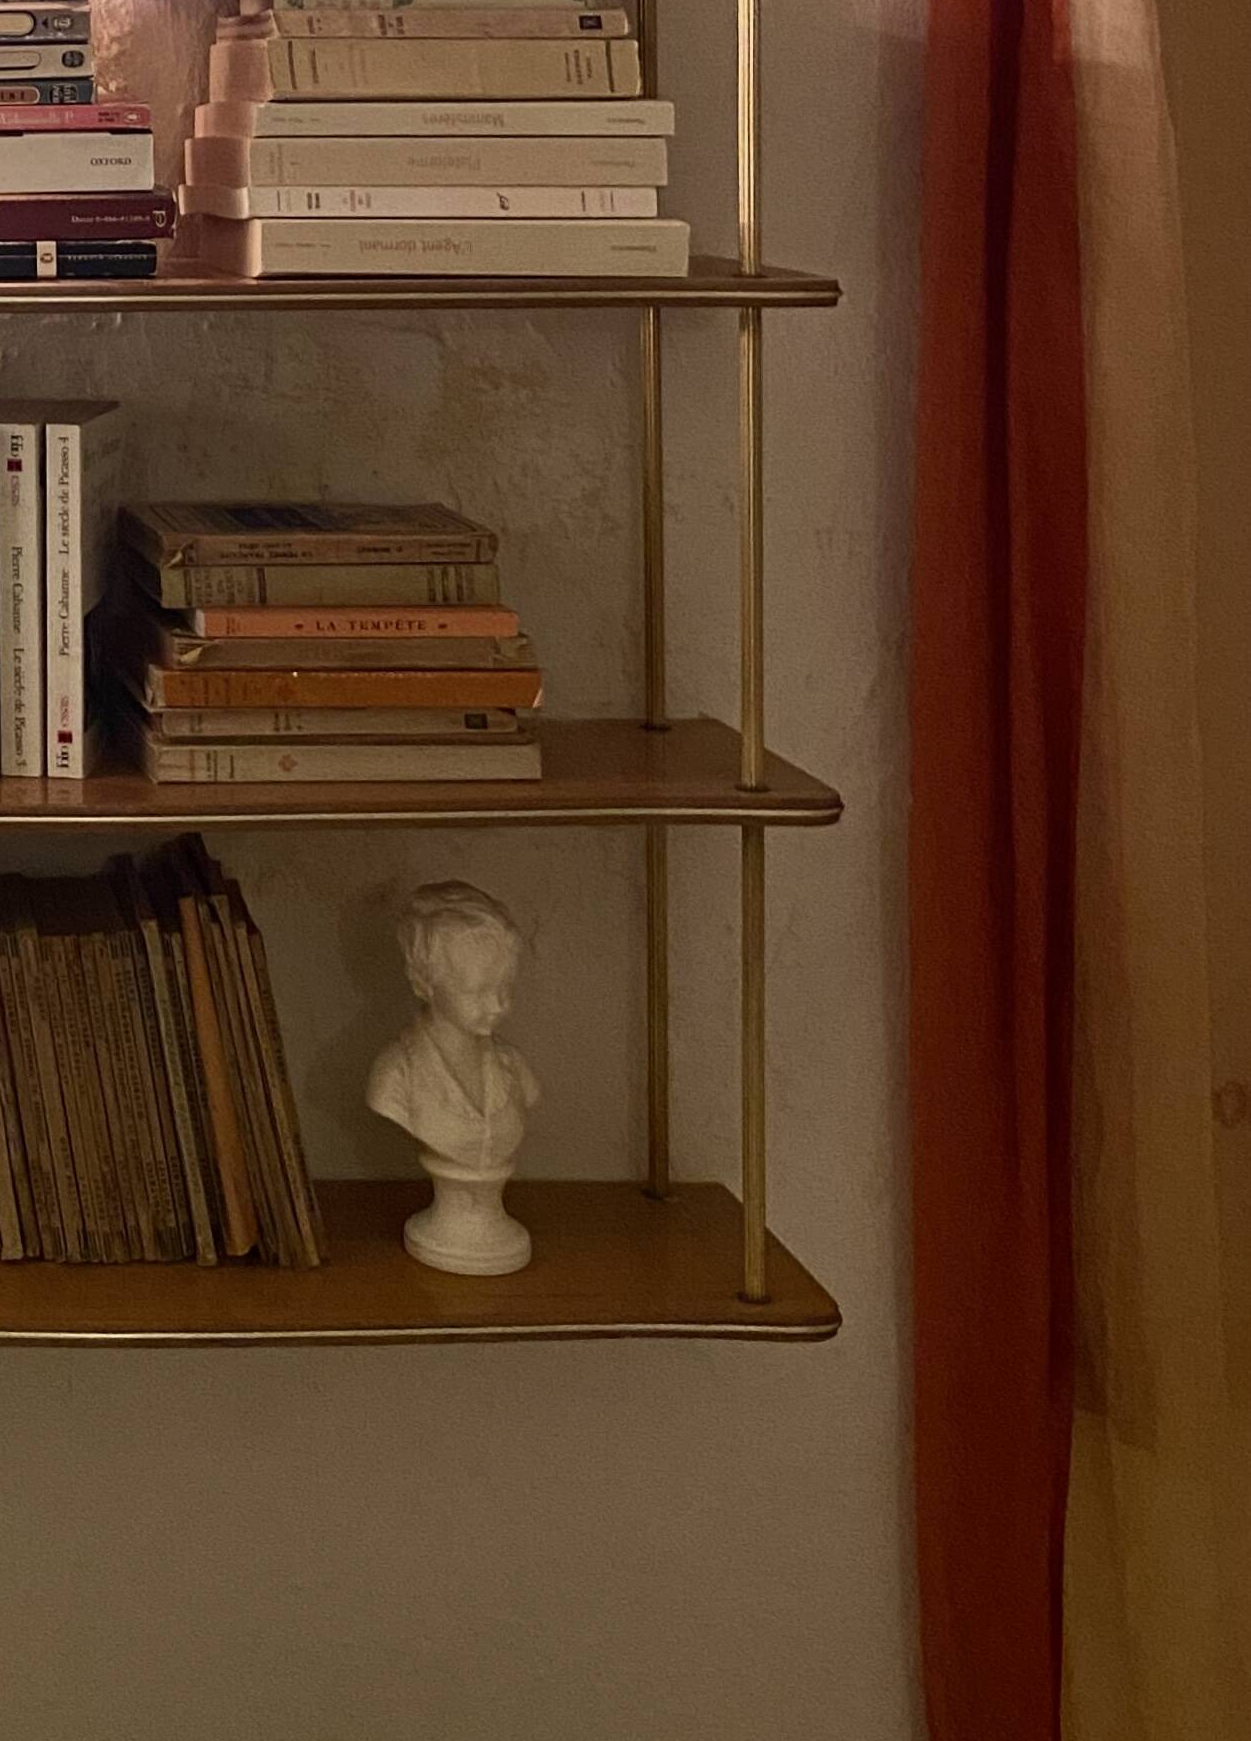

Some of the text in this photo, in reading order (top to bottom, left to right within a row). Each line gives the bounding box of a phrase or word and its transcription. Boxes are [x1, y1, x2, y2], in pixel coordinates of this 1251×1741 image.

[90, 157, 132, 166] OXFORD
[59, 448, 69, 485] Picasso
[59, 490, 69, 504] de
[59, 541, 69, 555] Le
[12, 547, 22, 580] Pierre
[315, 618, 427, 631] LA TEMPÊTE
[13, 648, 24, 663] Le
[15, 699, 25, 713] de
[15, 717, 25, 756] Picasso
